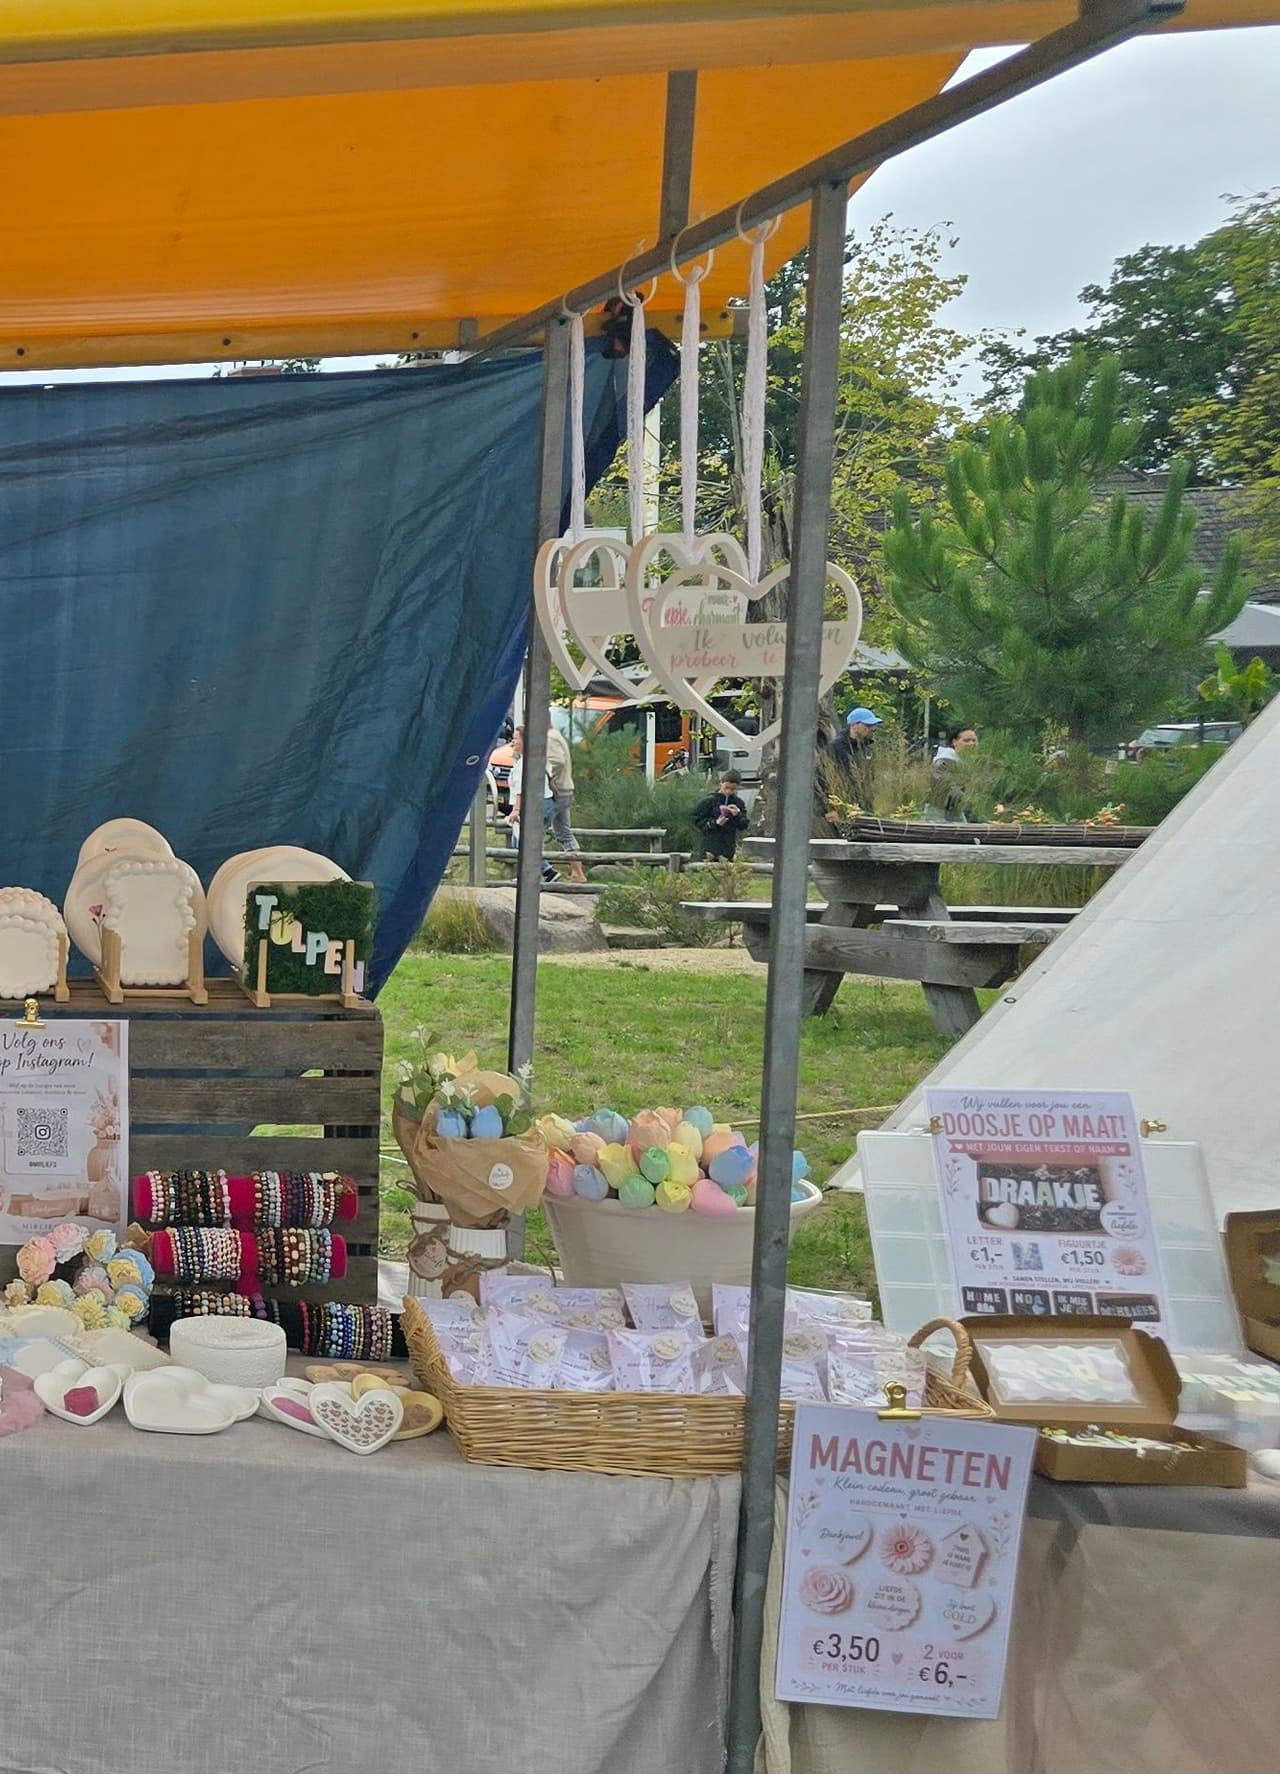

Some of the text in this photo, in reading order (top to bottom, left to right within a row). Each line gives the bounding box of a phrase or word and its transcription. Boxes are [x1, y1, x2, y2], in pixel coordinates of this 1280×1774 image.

[670, 651, 737, 672] probeer
[2, 1031, 65, 1055] Volg ons
[15, 1052, 95, 1075] Instagram!
[942, 1112, 1128, 1139] DOOSJE OP MAAT!
[983, 1176, 1101, 1211] DRAAKJE
[967, 1236, 1002, 1245] LETTER
[970, 1247, 1105, 1266] €1,- €1,50
[810, 1434, 1011, 1490] MAGNETEN
[813, 1633, 880, 1662] €3,50
[923, 1644, 934, 1660] 2
[822, 1662, 866, 1674] PER STUK
